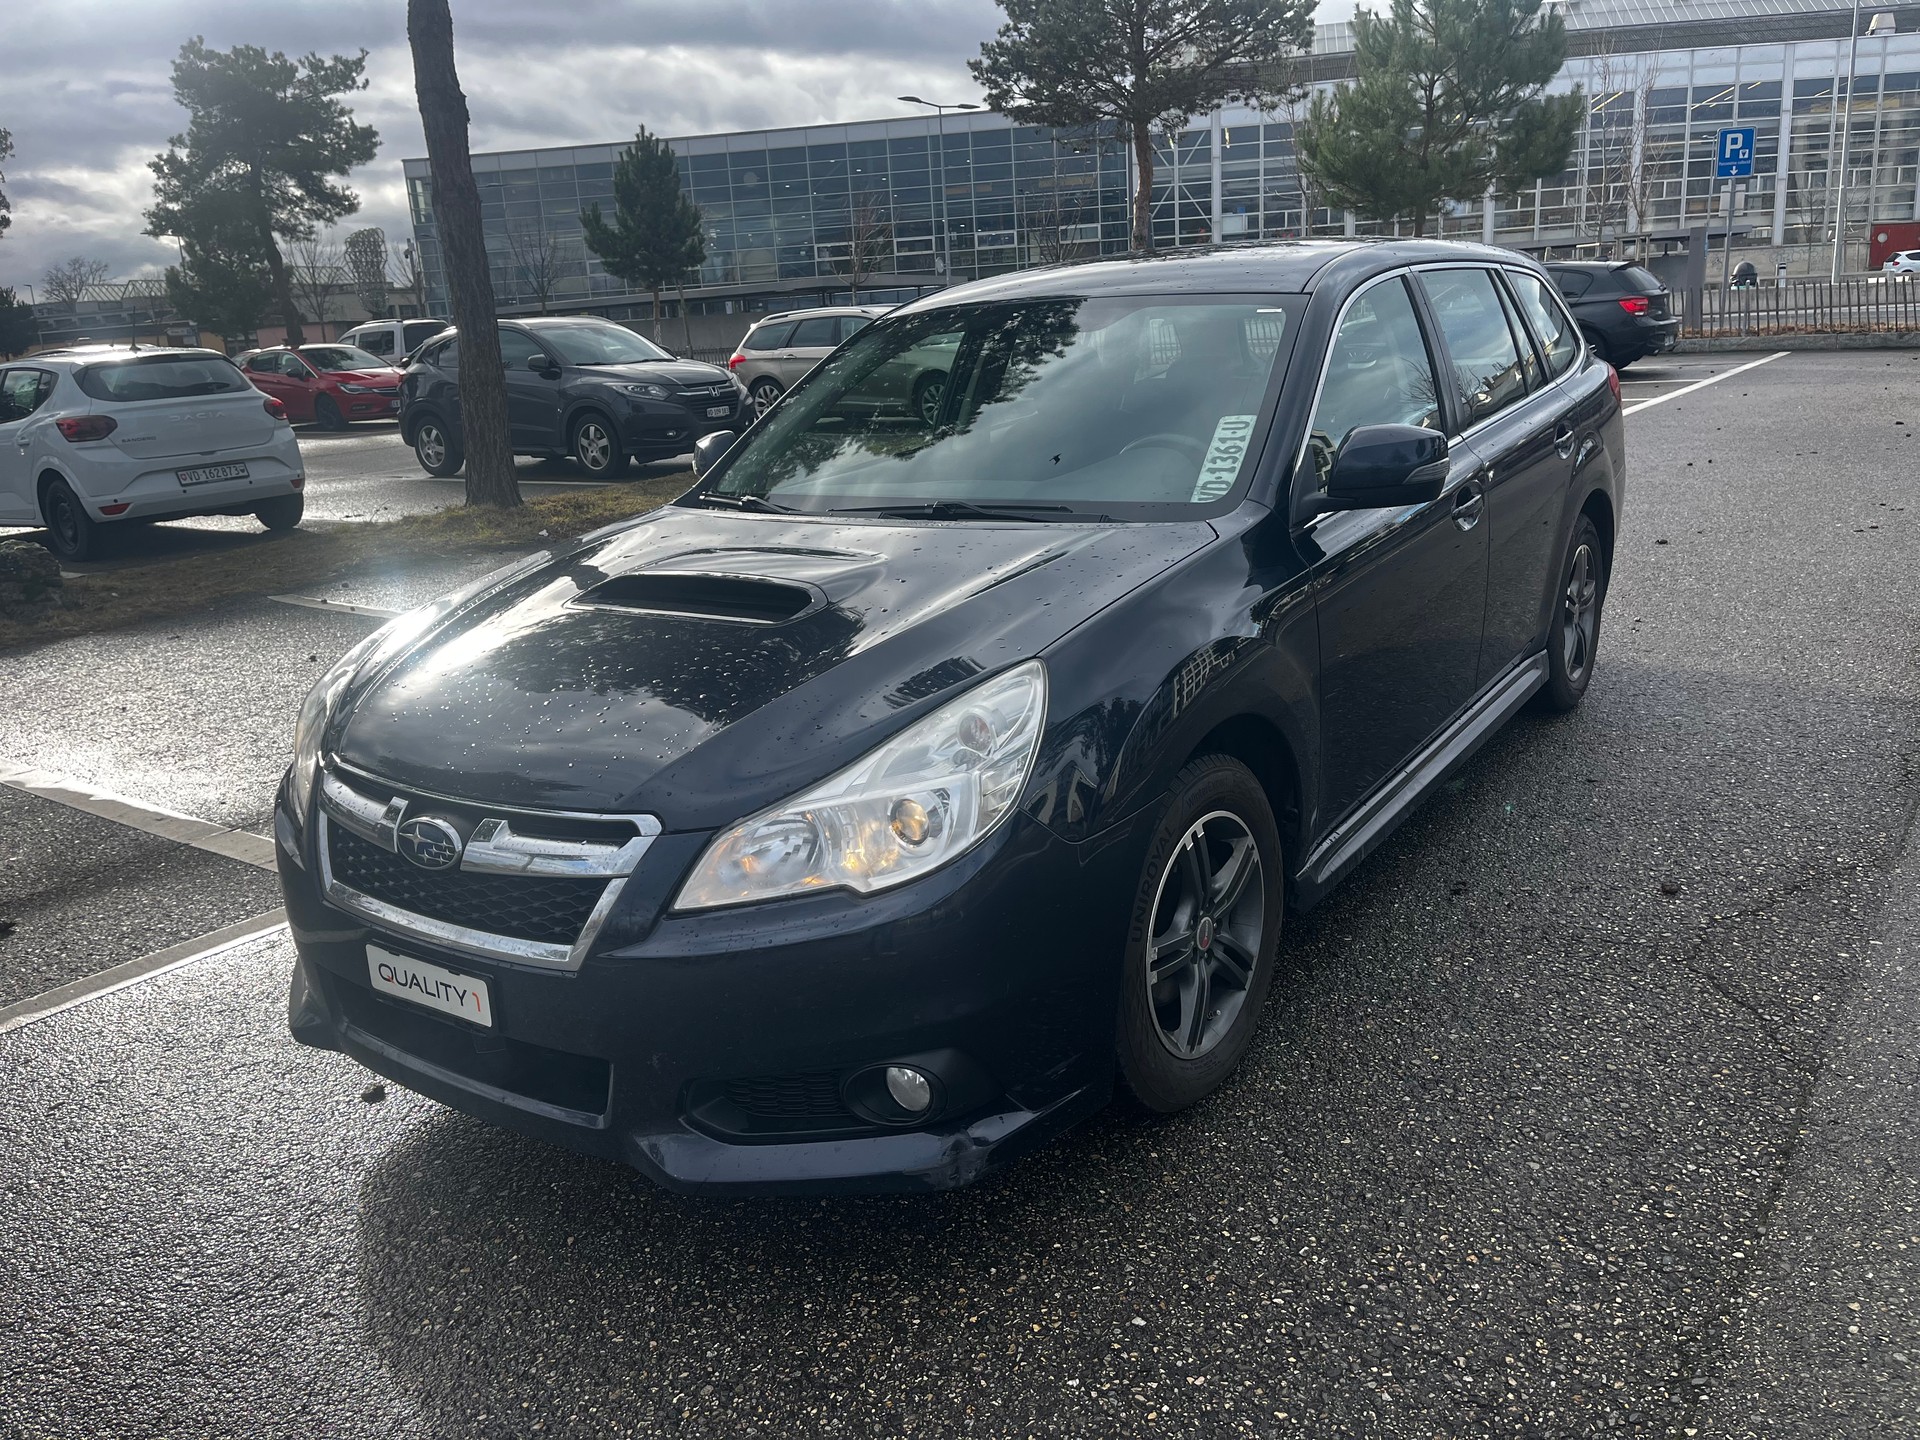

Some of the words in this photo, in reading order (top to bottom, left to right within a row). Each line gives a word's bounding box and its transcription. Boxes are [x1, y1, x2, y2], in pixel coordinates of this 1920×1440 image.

[1725, 133, 1743, 158] P
[169, 411, 226, 421] DACIA
[1131, 826, 1176, 942] UNIROYAL
[378, 963, 467, 1006] QUALITY
